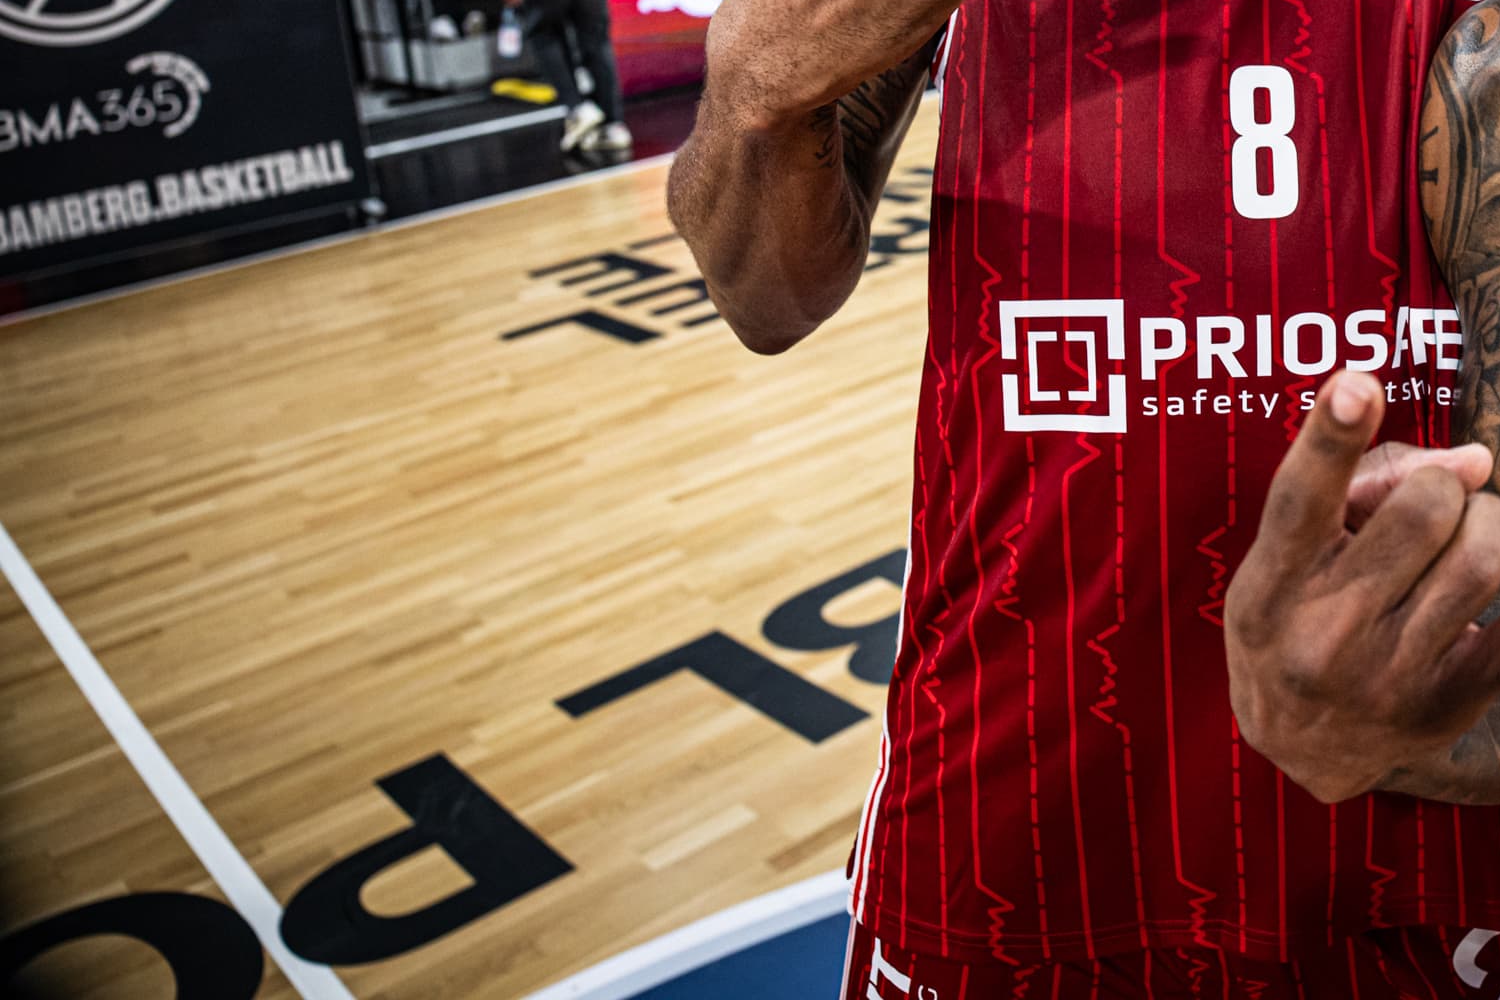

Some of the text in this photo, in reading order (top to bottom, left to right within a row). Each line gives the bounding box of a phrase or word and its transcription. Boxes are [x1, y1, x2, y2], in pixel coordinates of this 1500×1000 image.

[1230, 65, 1299, 219] 8
[1140, 306, 1464, 380] PRIOSAFE
[1142, 385, 1279, 419] safety
